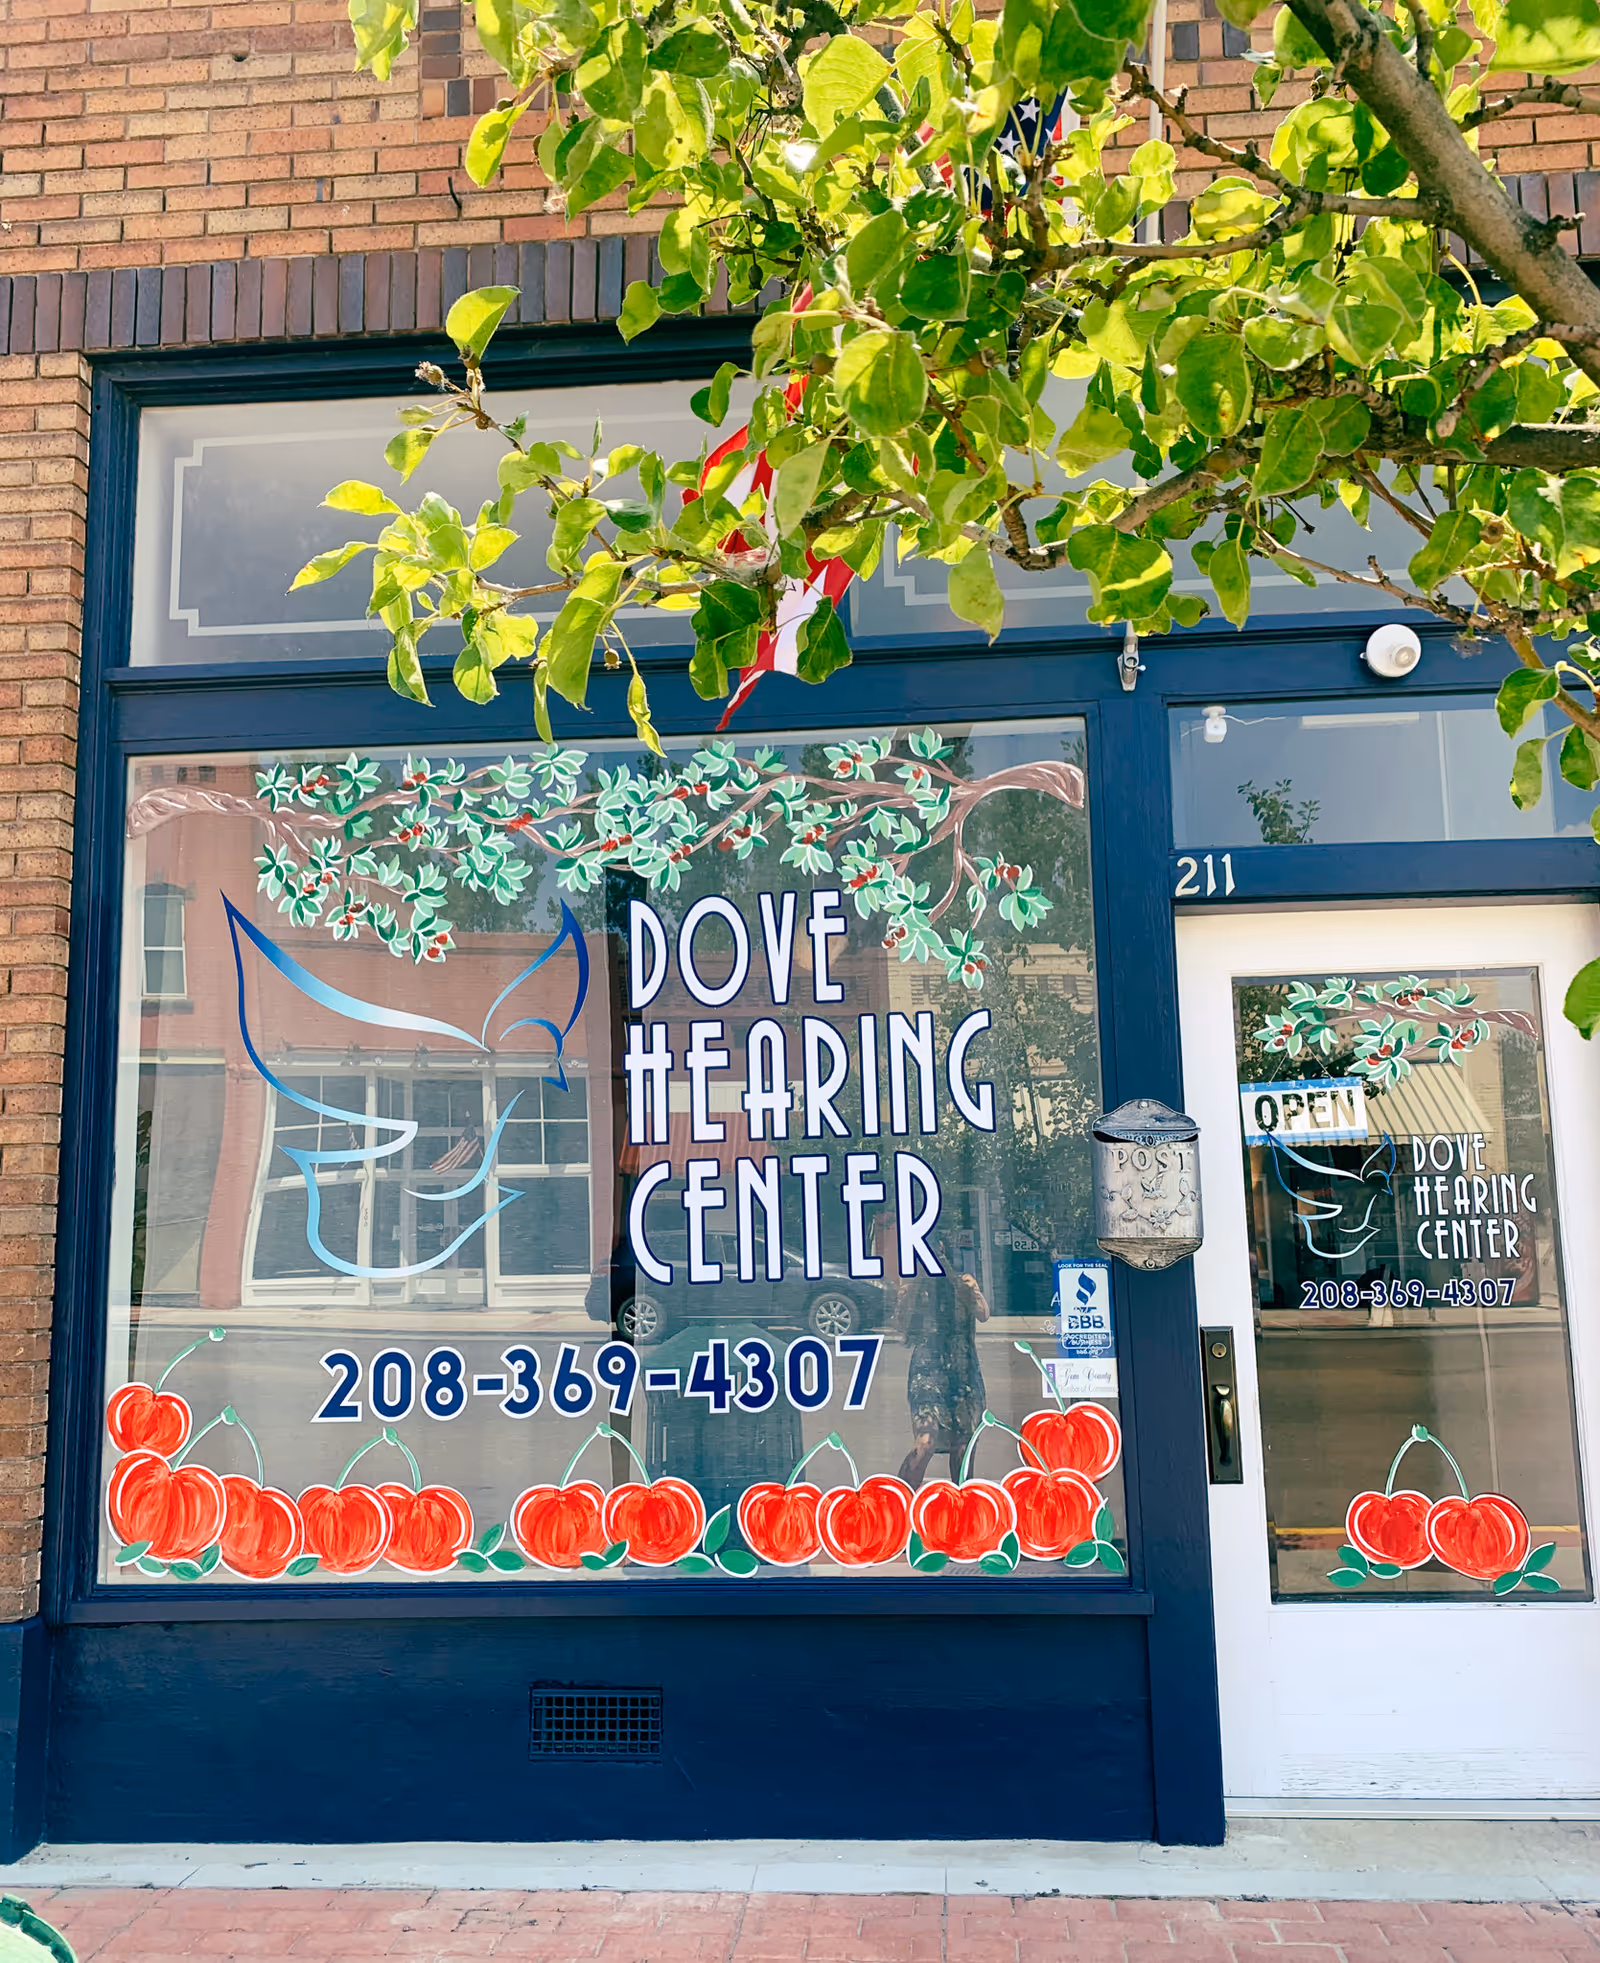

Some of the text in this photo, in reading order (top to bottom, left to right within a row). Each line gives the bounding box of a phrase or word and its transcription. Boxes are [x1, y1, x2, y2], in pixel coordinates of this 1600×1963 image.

[1175, 853, 1236, 897] 211
[628, 889, 847, 1009] DOVE
[624, 1008, 997, 1145] HEARING
[1255, 1090, 1356, 1132] OPEN
[1112, 1147, 1194, 1173] POST
[1412, 1133, 1486, 1172] DOVE
[1413, 1173, 1538, 1216] HEARING
[627, 1151, 947, 1286] CENTER
[1417, 1218, 1521, 1259] CENTER
[1299, 1278, 1516, 1309] 208-369-4307
[1068, 1315, 1105, 1329] BBB
[310, 1334, 885, 1423] 208-369-4307
